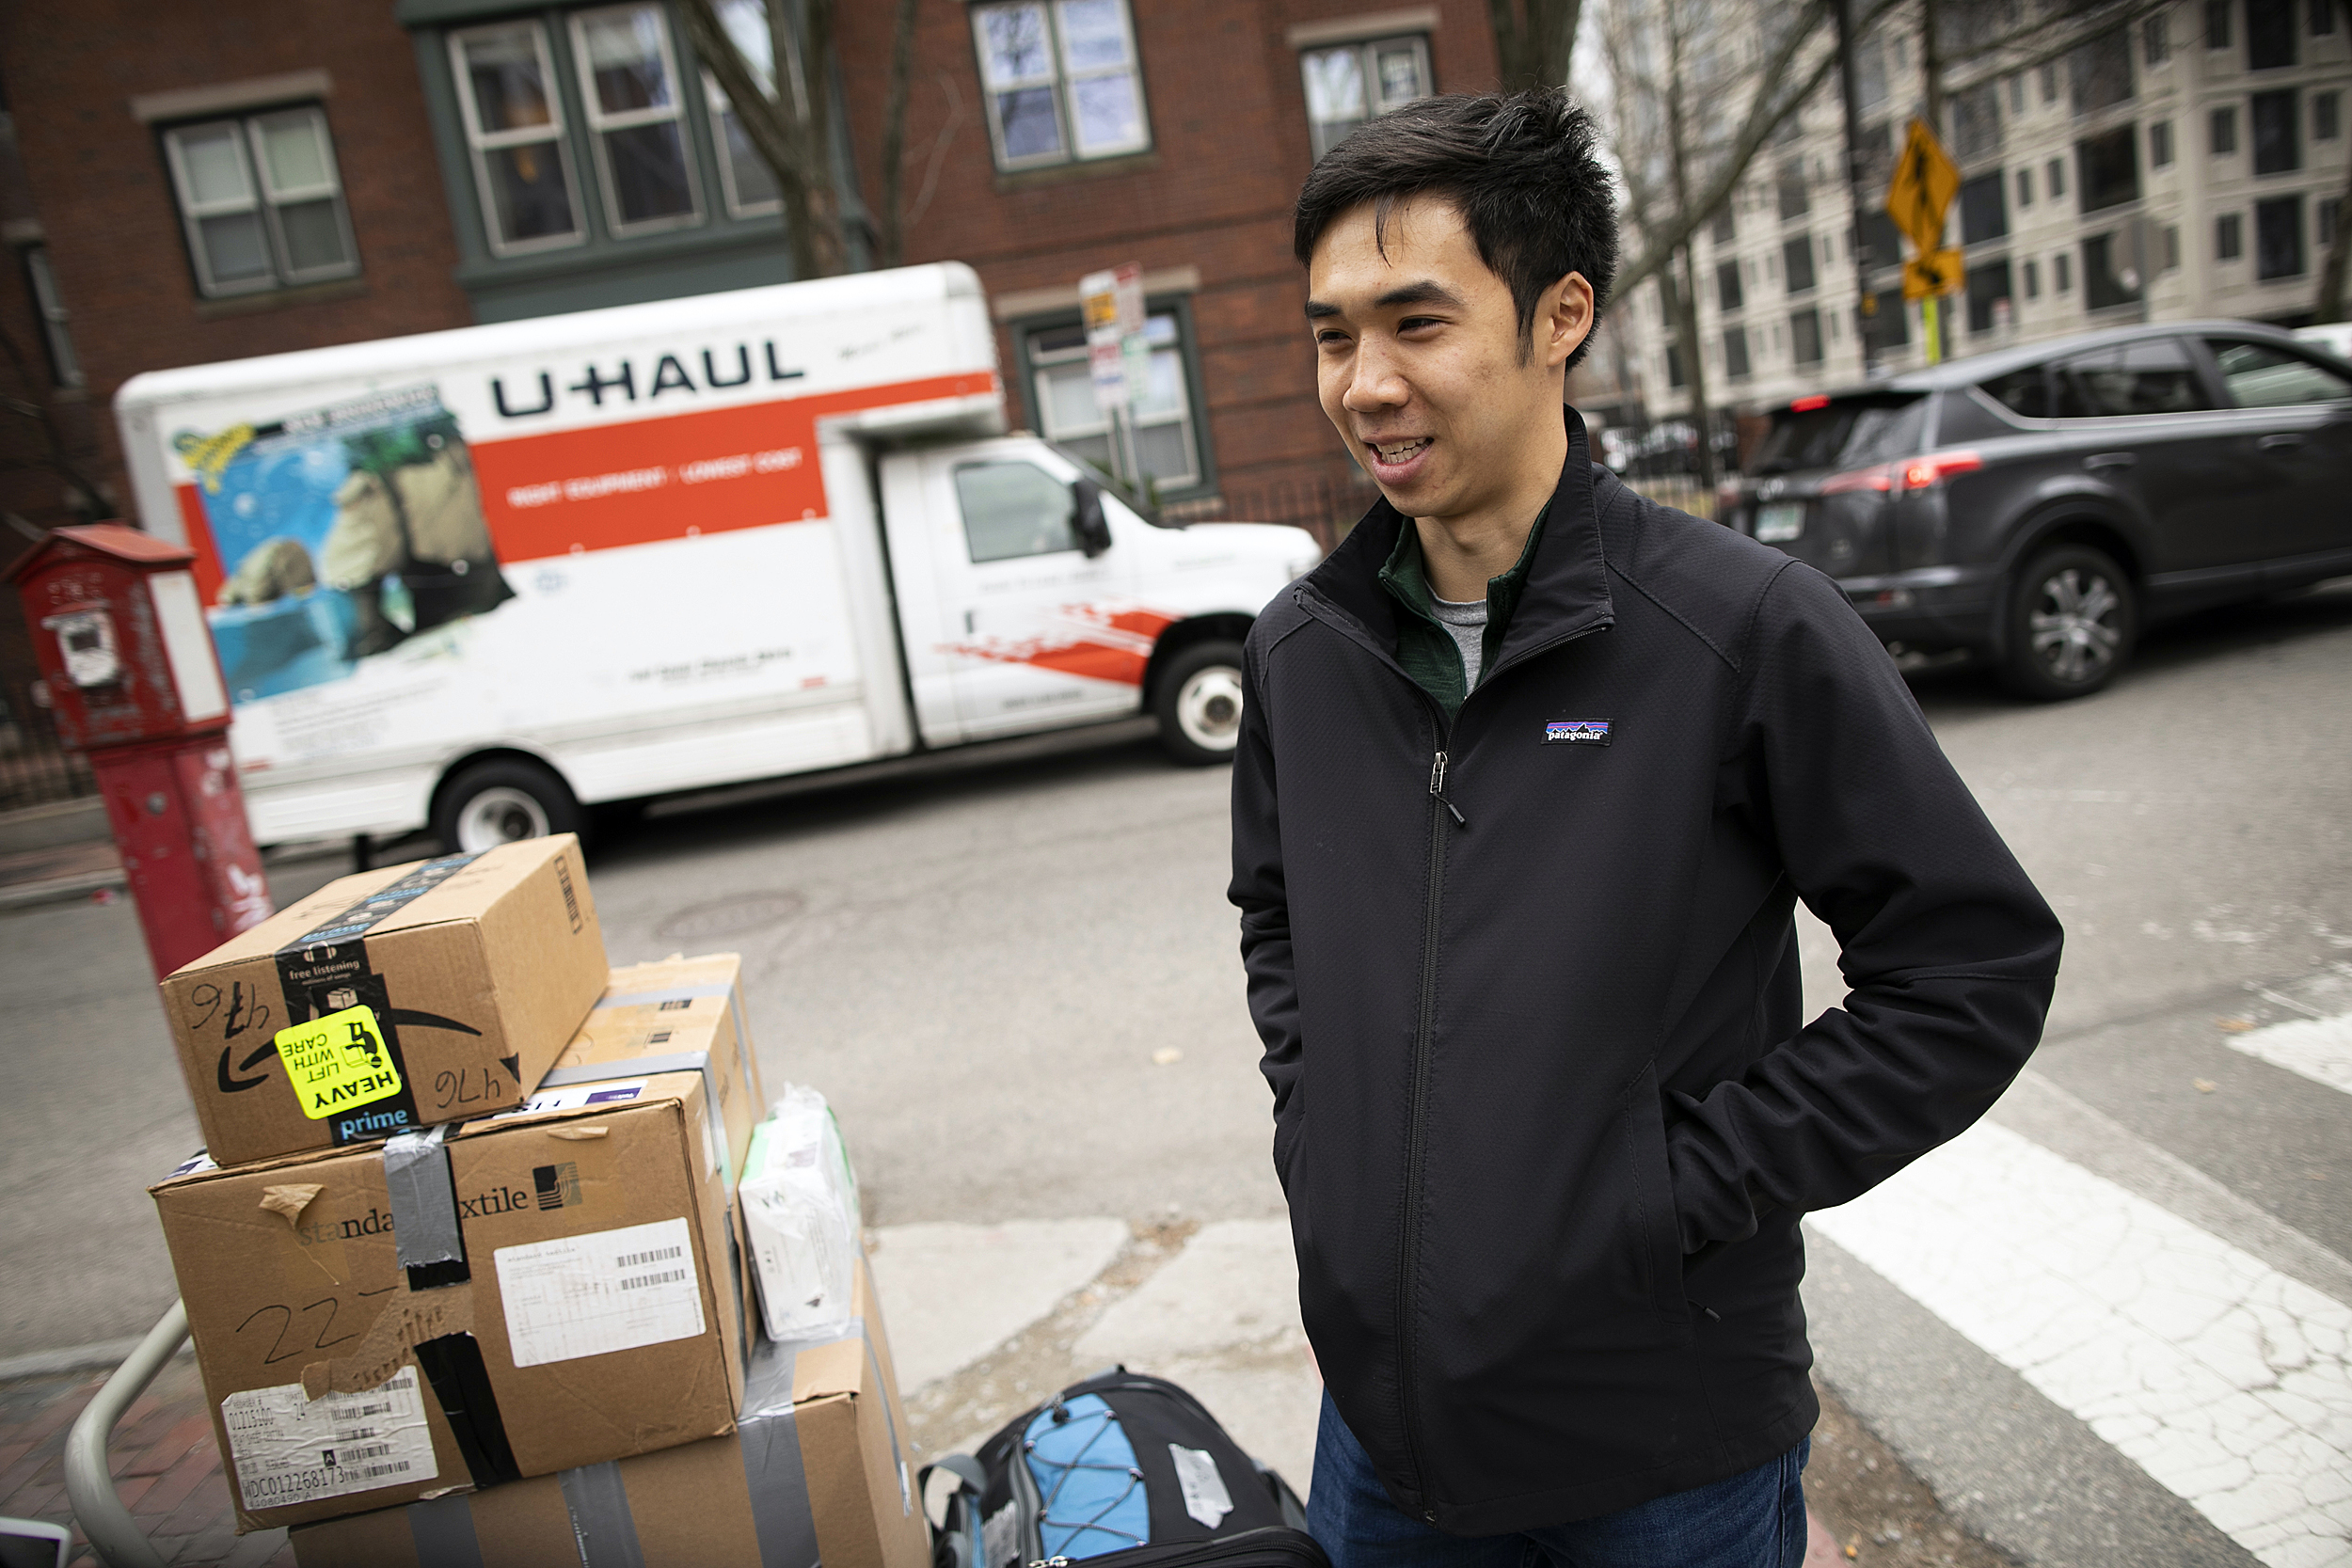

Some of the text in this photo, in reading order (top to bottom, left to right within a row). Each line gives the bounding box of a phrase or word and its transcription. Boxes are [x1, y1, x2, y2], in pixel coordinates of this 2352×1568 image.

[491, 339, 806, 418] U-HAUL
[1548, 731, 1601, 741] patagonia
[289, 959, 360, 981] free listening
[283, 1033, 327, 1057] CARE
[294, 1048, 334, 1070] WITH
[307, 1063, 340, 1084] LIFT
[315, 1070, 394, 1108] HEAVY
[435, 1069, 501, 1110] 476
[340, 1109, 408, 1140] prime
[299, 1186, 529, 1247] standa xtile
[235, 1286, 399, 1365] 22
[242, 1465, 345, 1499] WDC012268173
[247, 1491, 311, 1509] 44080490 A
